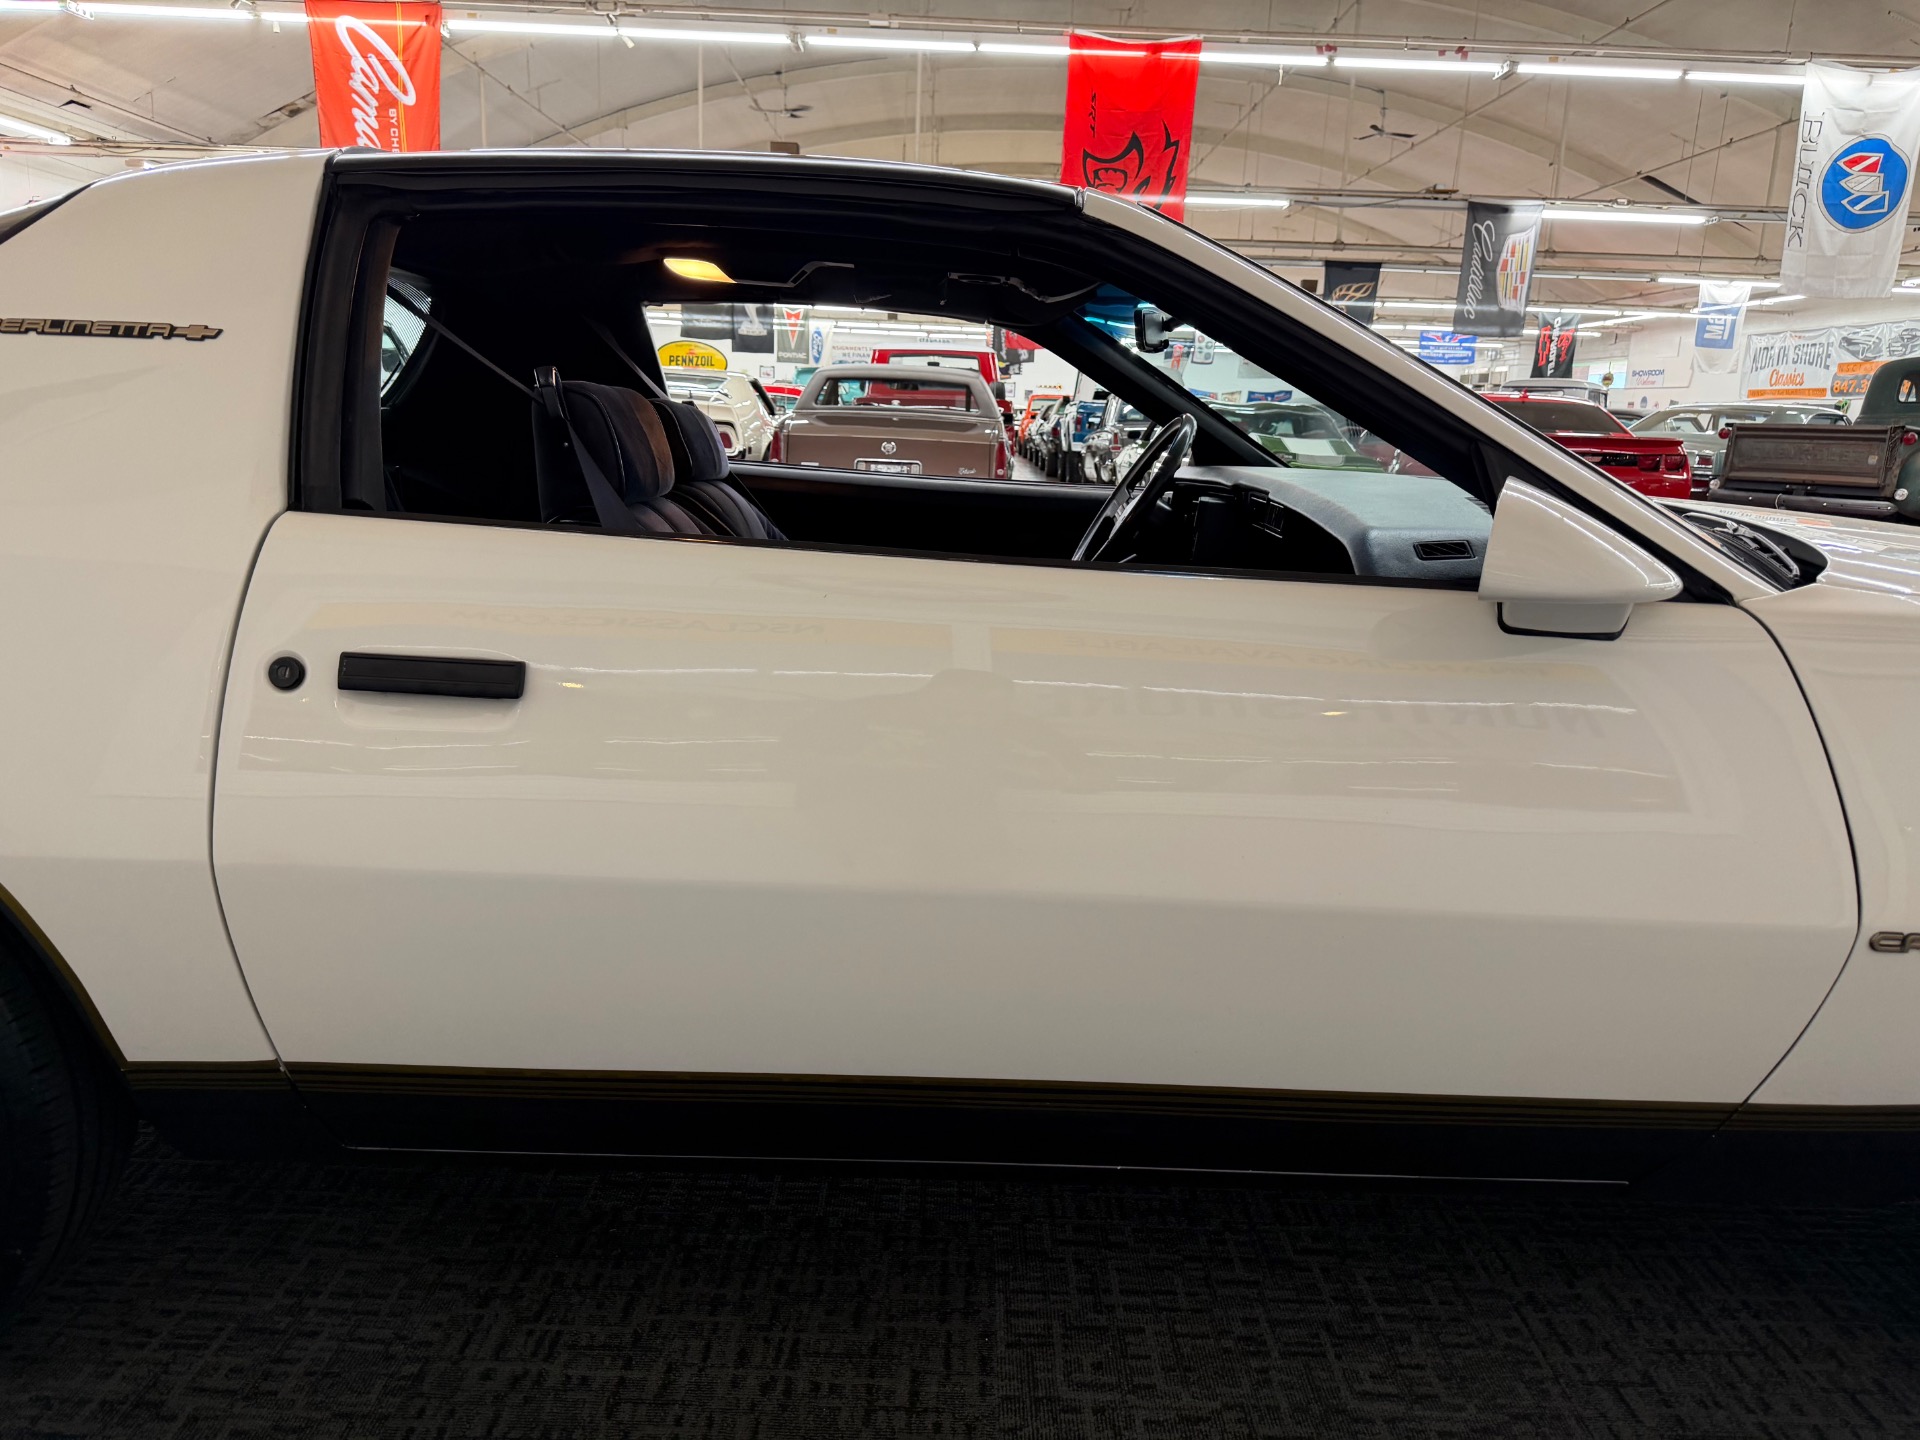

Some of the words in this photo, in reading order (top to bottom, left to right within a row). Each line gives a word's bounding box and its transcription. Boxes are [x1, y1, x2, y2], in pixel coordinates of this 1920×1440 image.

[388, 108, 398, 125] BY
[1787, 110, 1825, 248] BUICK
[1463, 219, 1496, 320] Cadillac
[0, 318, 173, 339] ERLINETTA
[669, 355, 715, 367] PENNZOIL
[778, 351, 808, 359] PONTIAC
[1750, 344, 1791, 374] NORTH
[1792, 341, 1834, 371] SHORE
[1632, 369, 1665, 377] SHOWROOM
[1769, 367, 1805, 388] Classics
